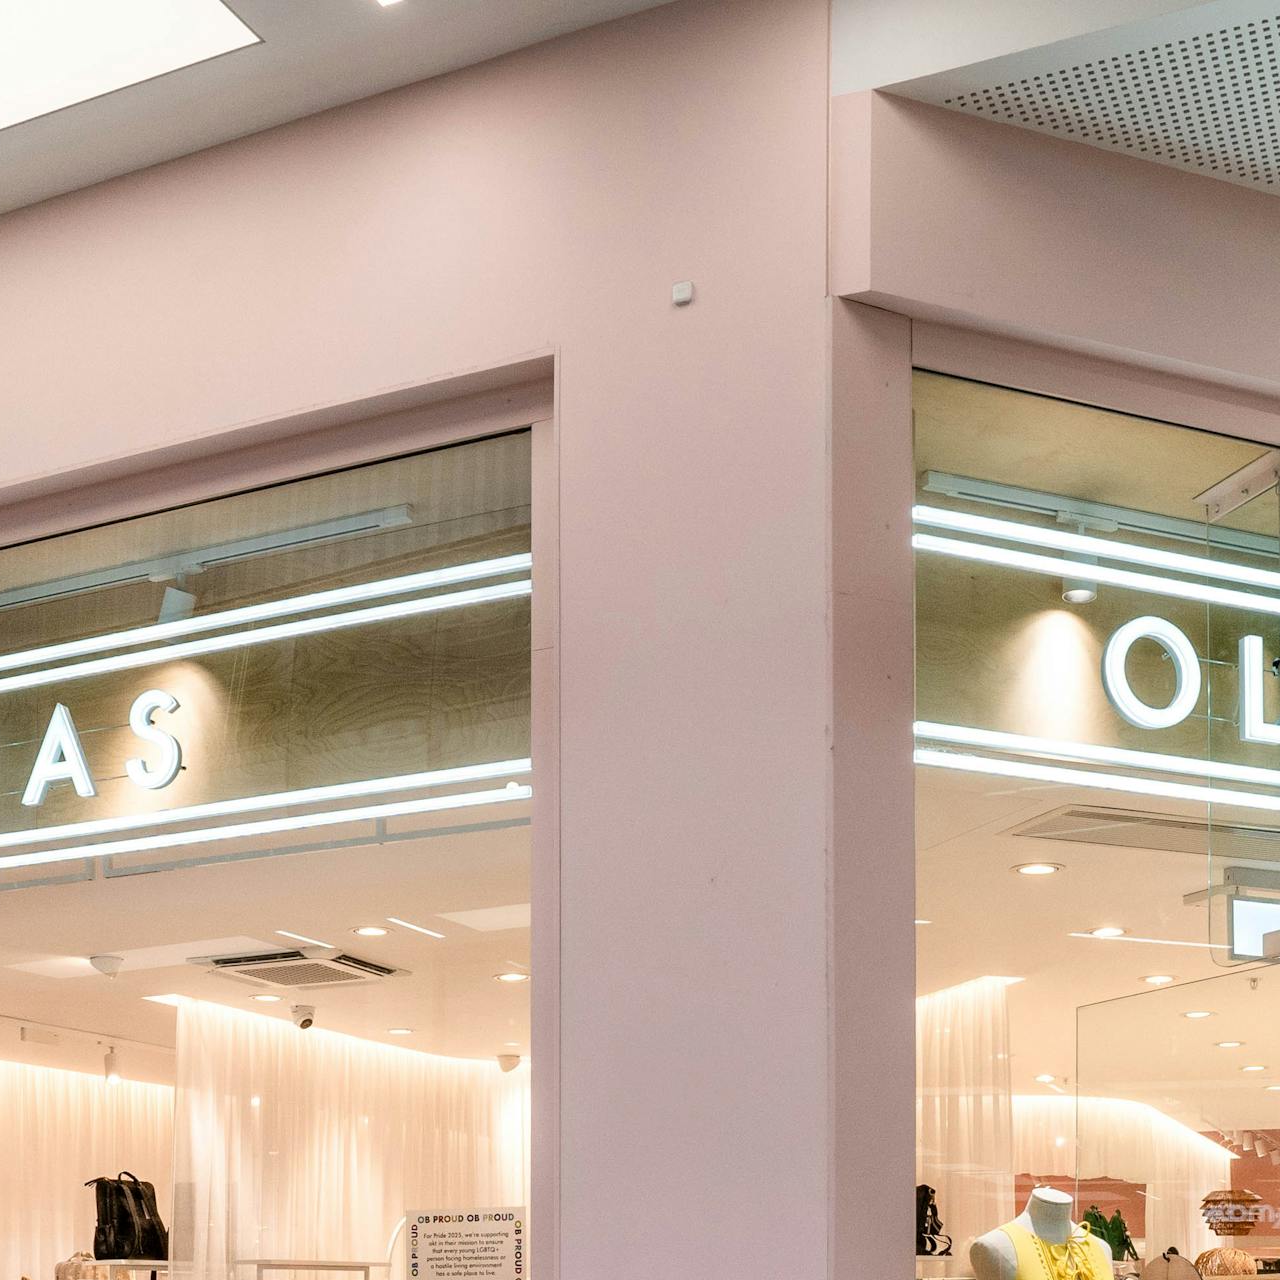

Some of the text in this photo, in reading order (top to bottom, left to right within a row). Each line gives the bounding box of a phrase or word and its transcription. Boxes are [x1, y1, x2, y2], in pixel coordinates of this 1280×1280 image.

[417, 1213, 514, 1224] OB PROUD OB PROUD
[514, 1220, 522, 1235] OB
[412, 1262, 419, 1277] OB
